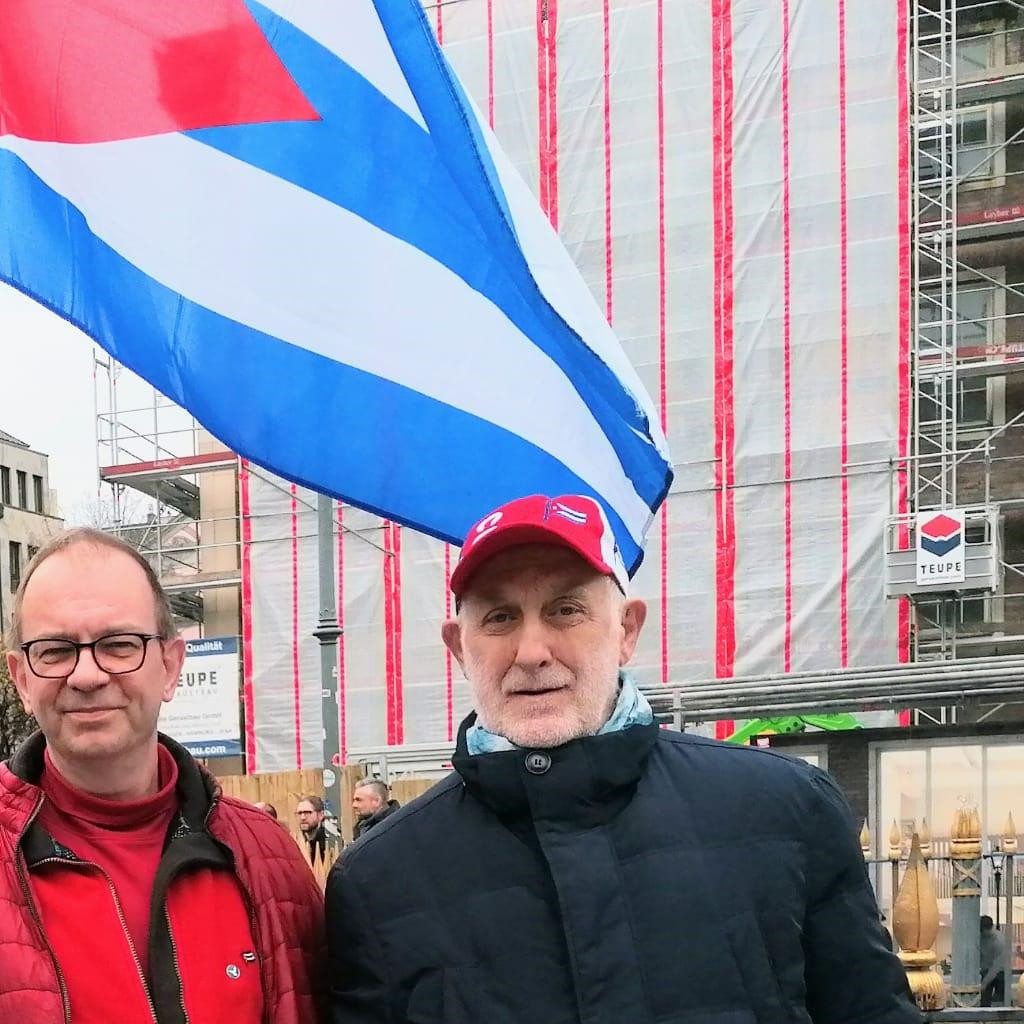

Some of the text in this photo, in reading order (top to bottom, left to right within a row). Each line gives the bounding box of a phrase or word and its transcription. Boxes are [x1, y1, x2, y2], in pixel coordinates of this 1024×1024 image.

[921, 562, 961, 574] TEUPE
[186, 640, 224, 653] Qualität
[176, 671, 217, 688] EUPE
